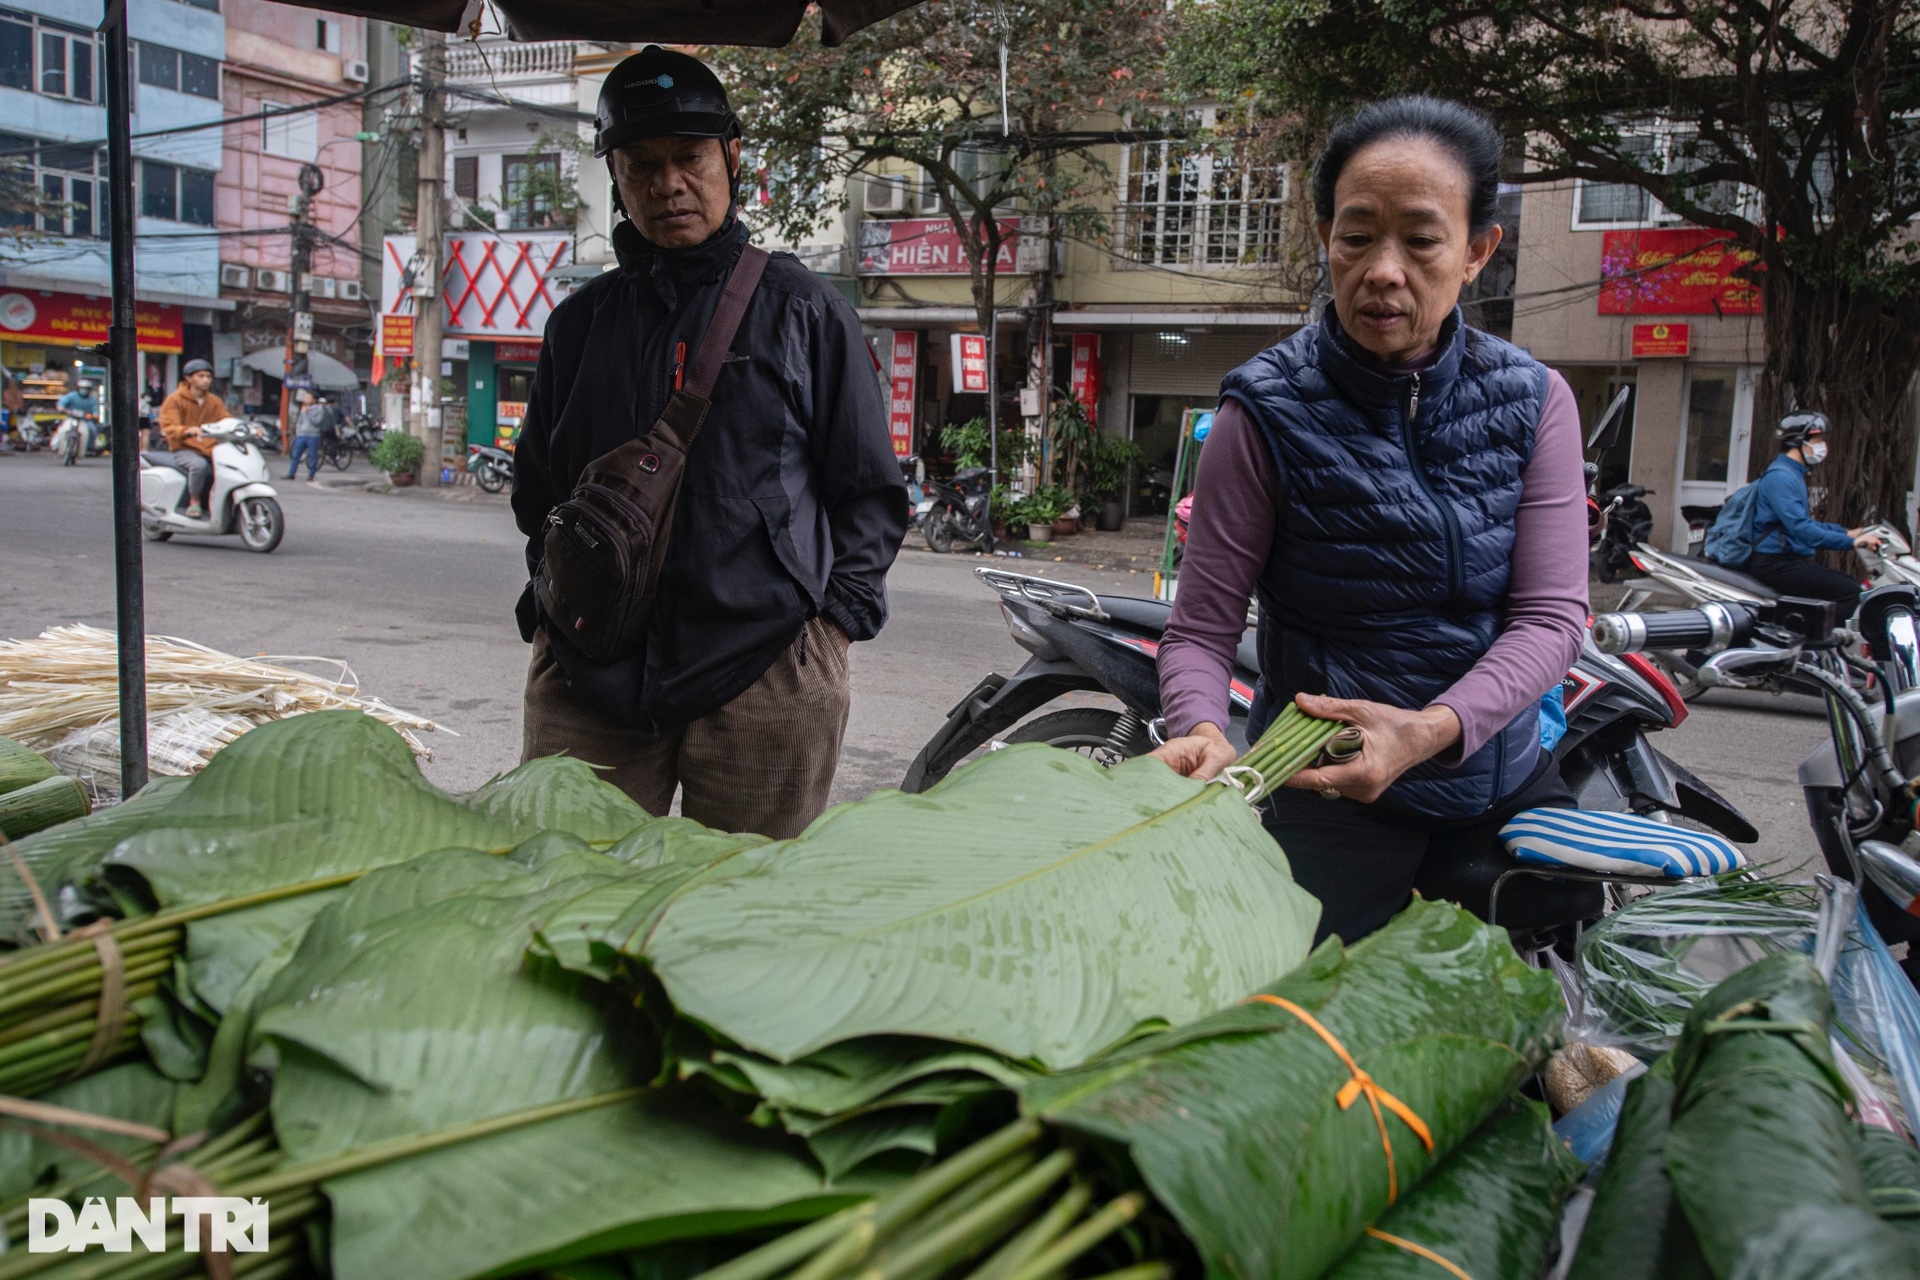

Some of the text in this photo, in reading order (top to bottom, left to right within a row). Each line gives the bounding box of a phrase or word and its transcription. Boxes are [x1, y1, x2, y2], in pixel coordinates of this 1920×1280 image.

[925, 222, 950, 234] NHÀ
[892, 236, 1013, 265] HIỀN HA
